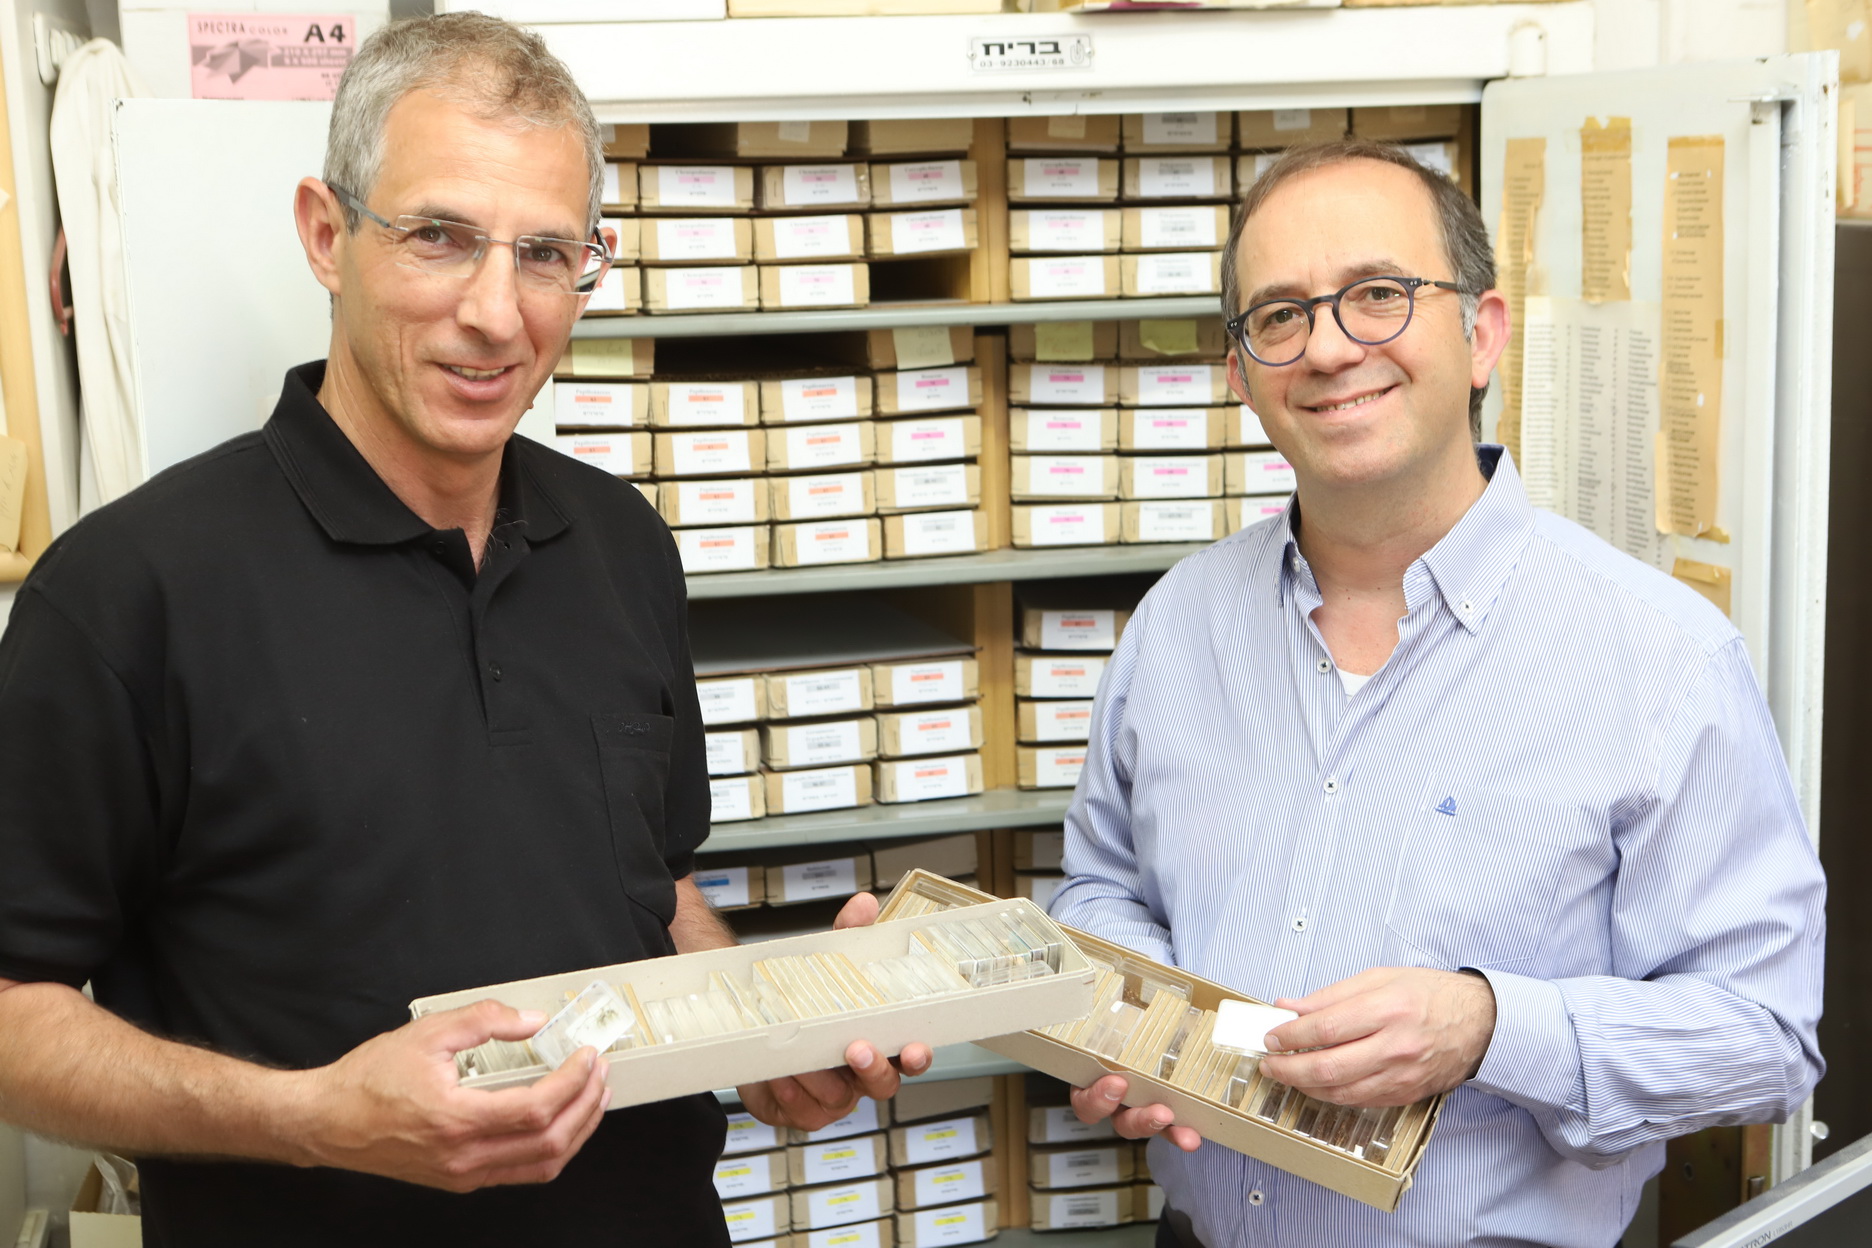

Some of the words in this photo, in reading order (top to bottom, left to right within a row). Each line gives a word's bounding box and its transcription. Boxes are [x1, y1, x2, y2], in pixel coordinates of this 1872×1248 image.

[197, 20, 246, 34] SPECTRA
[249, 26, 288, 35] COLOR
[304, 23, 346, 43] A4
[981, 41, 1062, 57] בריח
